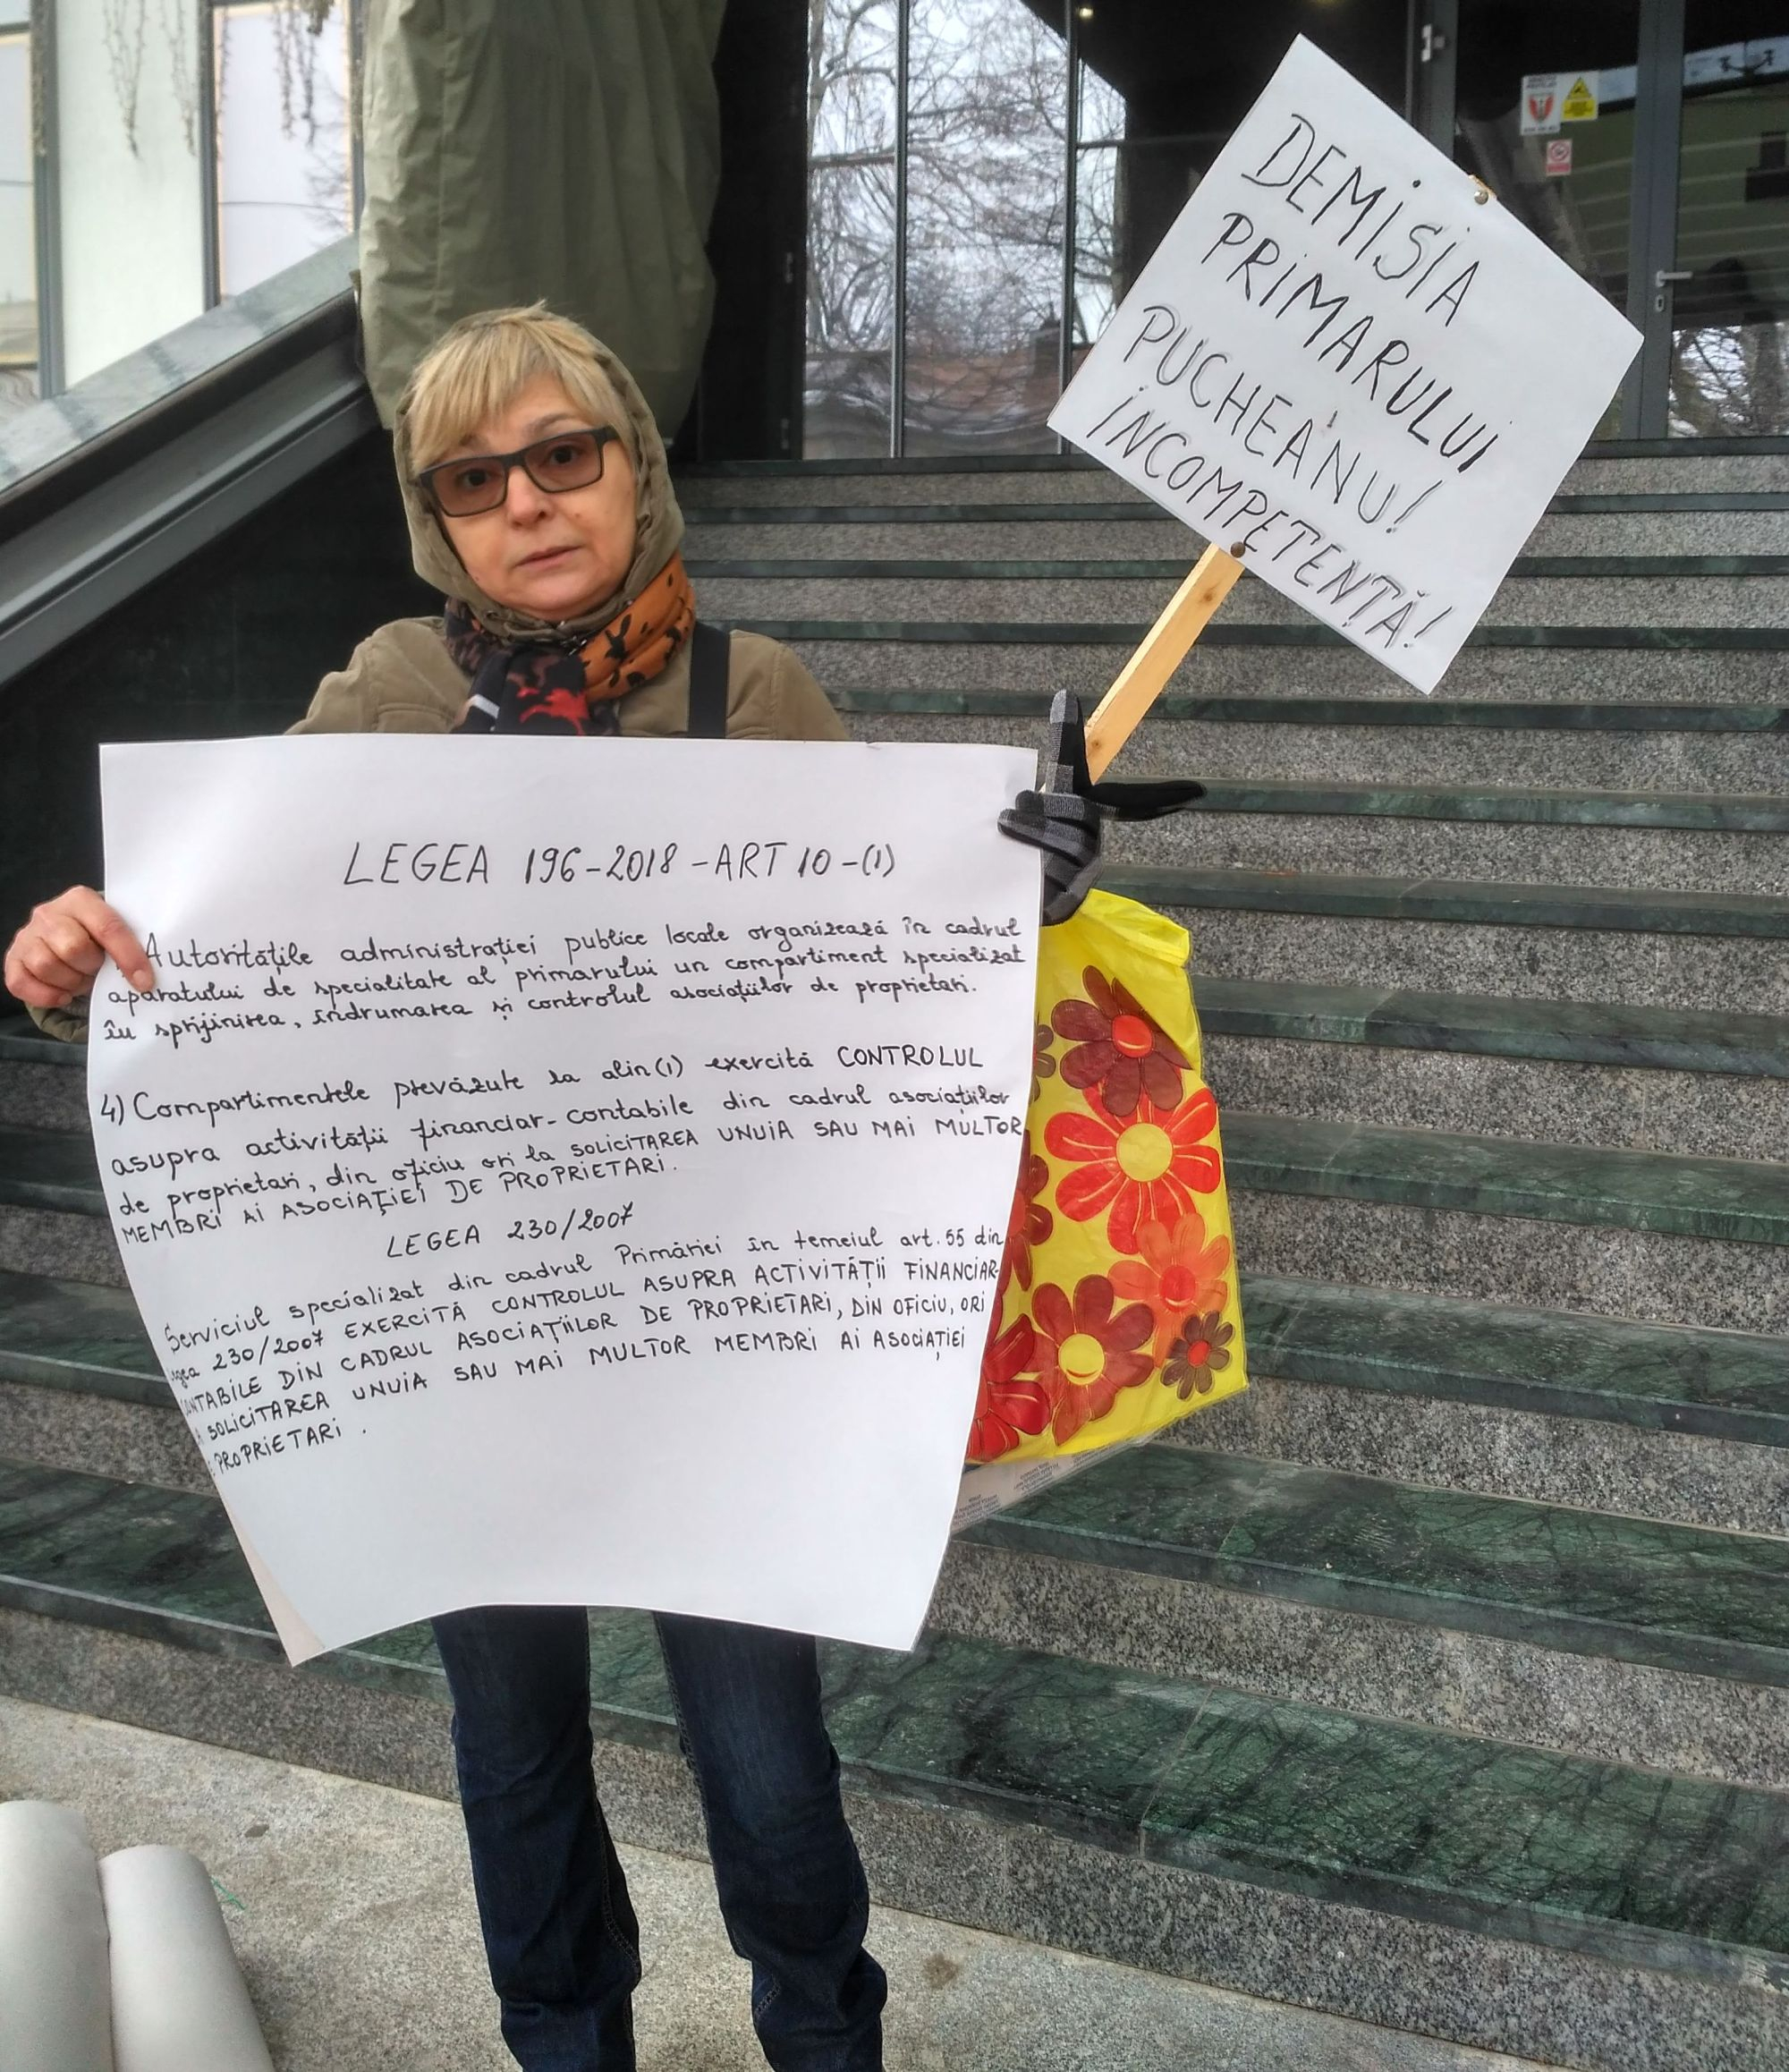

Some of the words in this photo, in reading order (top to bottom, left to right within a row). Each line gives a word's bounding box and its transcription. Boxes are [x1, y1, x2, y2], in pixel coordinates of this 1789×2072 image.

[1122, 305, 1444, 534] PUCHEANU!
[343, 841, 488, 886] LEGEA
[263, 975, 296, 998] de
[314, 969, 453, 1011] specialitate
[467, 964, 496, 986] al
[514, 955, 658, 993] primarului
[674, 959, 710, 973] un
[725, 944, 888, 981] compartiment
[903, 943, 1026, 975] specializat
[564, 928, 648, 965] publice
[665, 921, 730, 945] locale
[901, 915, 931, 936] în
[945, 915, 1022, 938] cadrul
[527, 981, 651, 1010] controlul
[810, 975, 839, 993] de
[548, 1068, 581, 1085] la
[837, 1043, 984, 1068] CONTROLUL
[111, 1147, 221, 1181] asupra
[722, 1090, 771, 1111] din
[788, 1083, 872, 1106] cadrul
[119, 1191, 150, 1217] de
[326, 1162, 377, 1187] din
[392, 1155, 465, 1191] oficiu
[481, 1151, 515, 1168] ori
[525, 1143, 556, 1163] la
[570, 1127, 700, 1158] SOLICITAREA
[716, 1118, 795, 1143] UNUIA
[813, 1119, 860, 1139] SAU
[871, 1115, 916, 1139] MAI
[935, 1115, 1023, 1137] MULTOR
[121, 1208, 223, 1244] MEMBRI
[242, 1202, 266, 1225] AI
[445, 1177, 484, 1204] DE
[386, 1224, 480, 1259] LEGEA
[506, 1201, 634, 1241] 230/2007
[164, 1305, 271, 1354] Serviciul
[288, 1279, 425, 1326] specializat
[448, 1272, 493, 1291] din
[504, 1253, 593, 1284] cadrul
[794, 1226, 884, 1250] temeiul
[945, 1227, 965, 1247] 55
[974, 1224, 1005, 1246] din
[211, 1329, 324, 1371] 230/2007
[491, 1282, 625, 1313] CONTROLUL
[643, 1269, 737, 1293] ASUPRA
[278, 1361, 324, 1390] DIN
[341, 1341, 433, 1372] CADRUL
[640, 1304, 673, 1325] DE
[852, 1295, 883, 1318] DIN
[960, 1290, 986, 1313] ORI
[207, 1390, 330, 1441] SOLICITAREA
[352, 1371, 428, 1401] UNUIA
[454, 1362, 497, 1381] SAU
[514, 1350, 564, 1376] MAI
[588, 1334, 691, 1366] MULTOR
[714, 1327, 818, 1353] MEMBRI
[840, 1327, 861, 1351] AI
